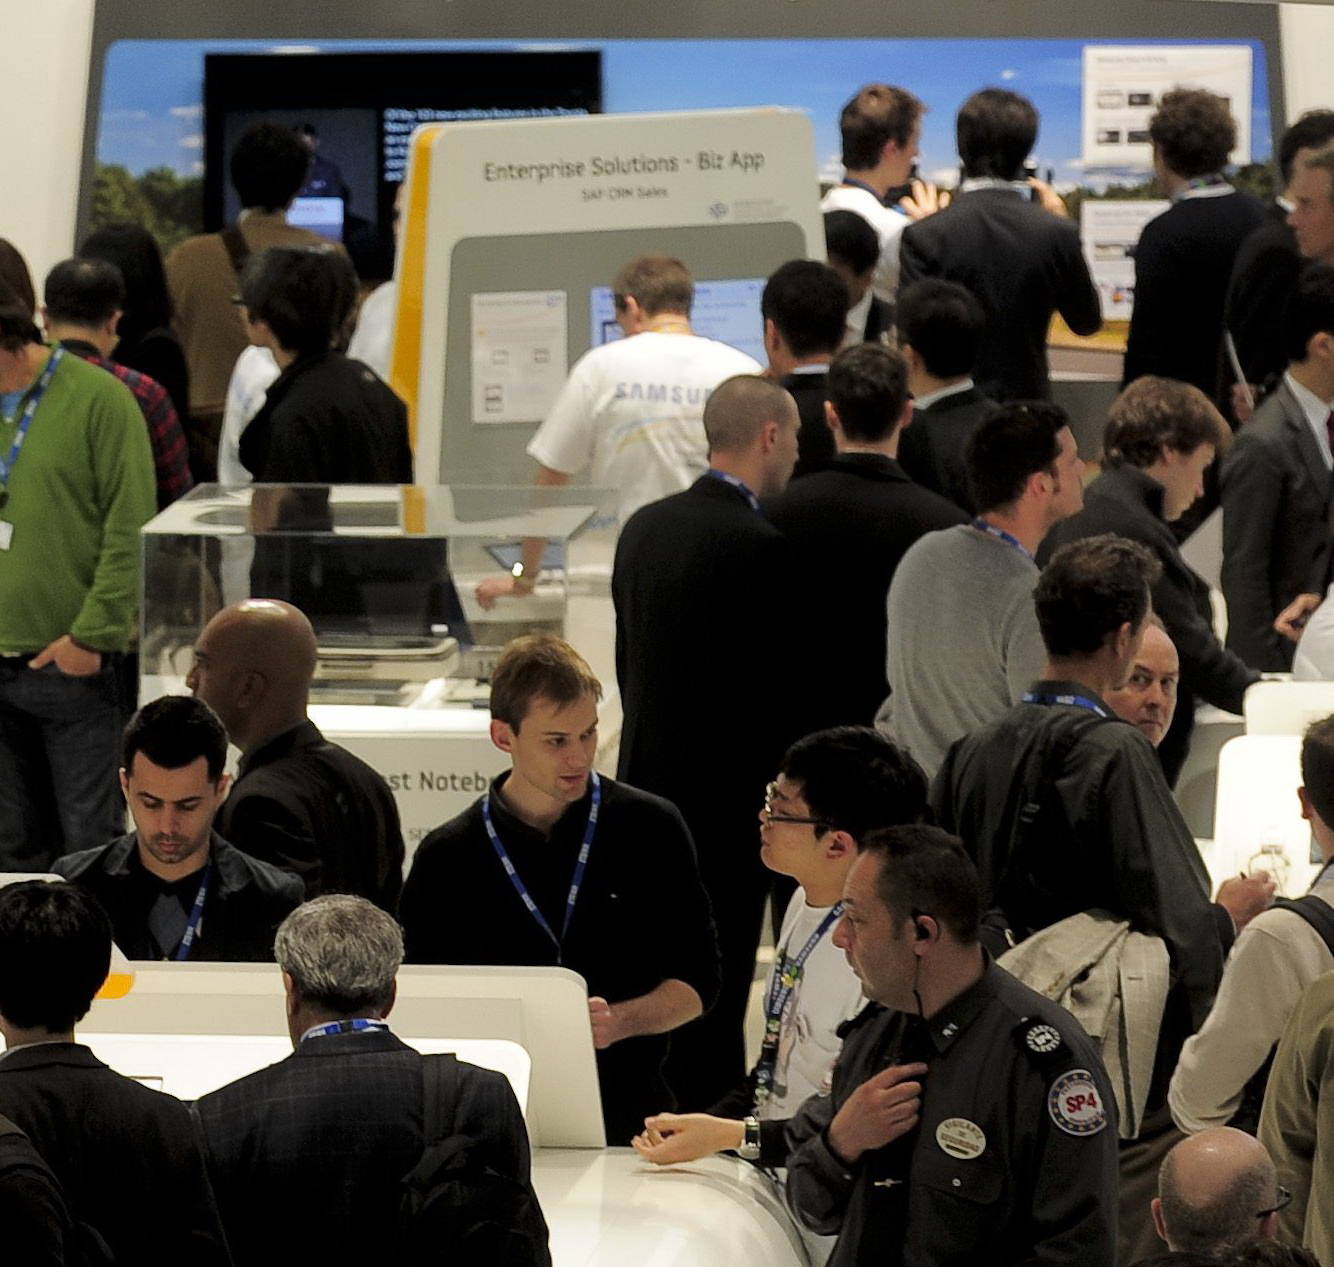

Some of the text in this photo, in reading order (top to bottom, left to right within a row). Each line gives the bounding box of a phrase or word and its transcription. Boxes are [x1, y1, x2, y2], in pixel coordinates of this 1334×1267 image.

[484, 157, 586, 184] Enterprise
[590, 155, 680, 178] Solutions
[697, 150, 724, 171] Biz
[731, 150, 766, 173] App
[616, 382, 712, 405] SAMSU
[420, 770, 492, 792] Noteb
